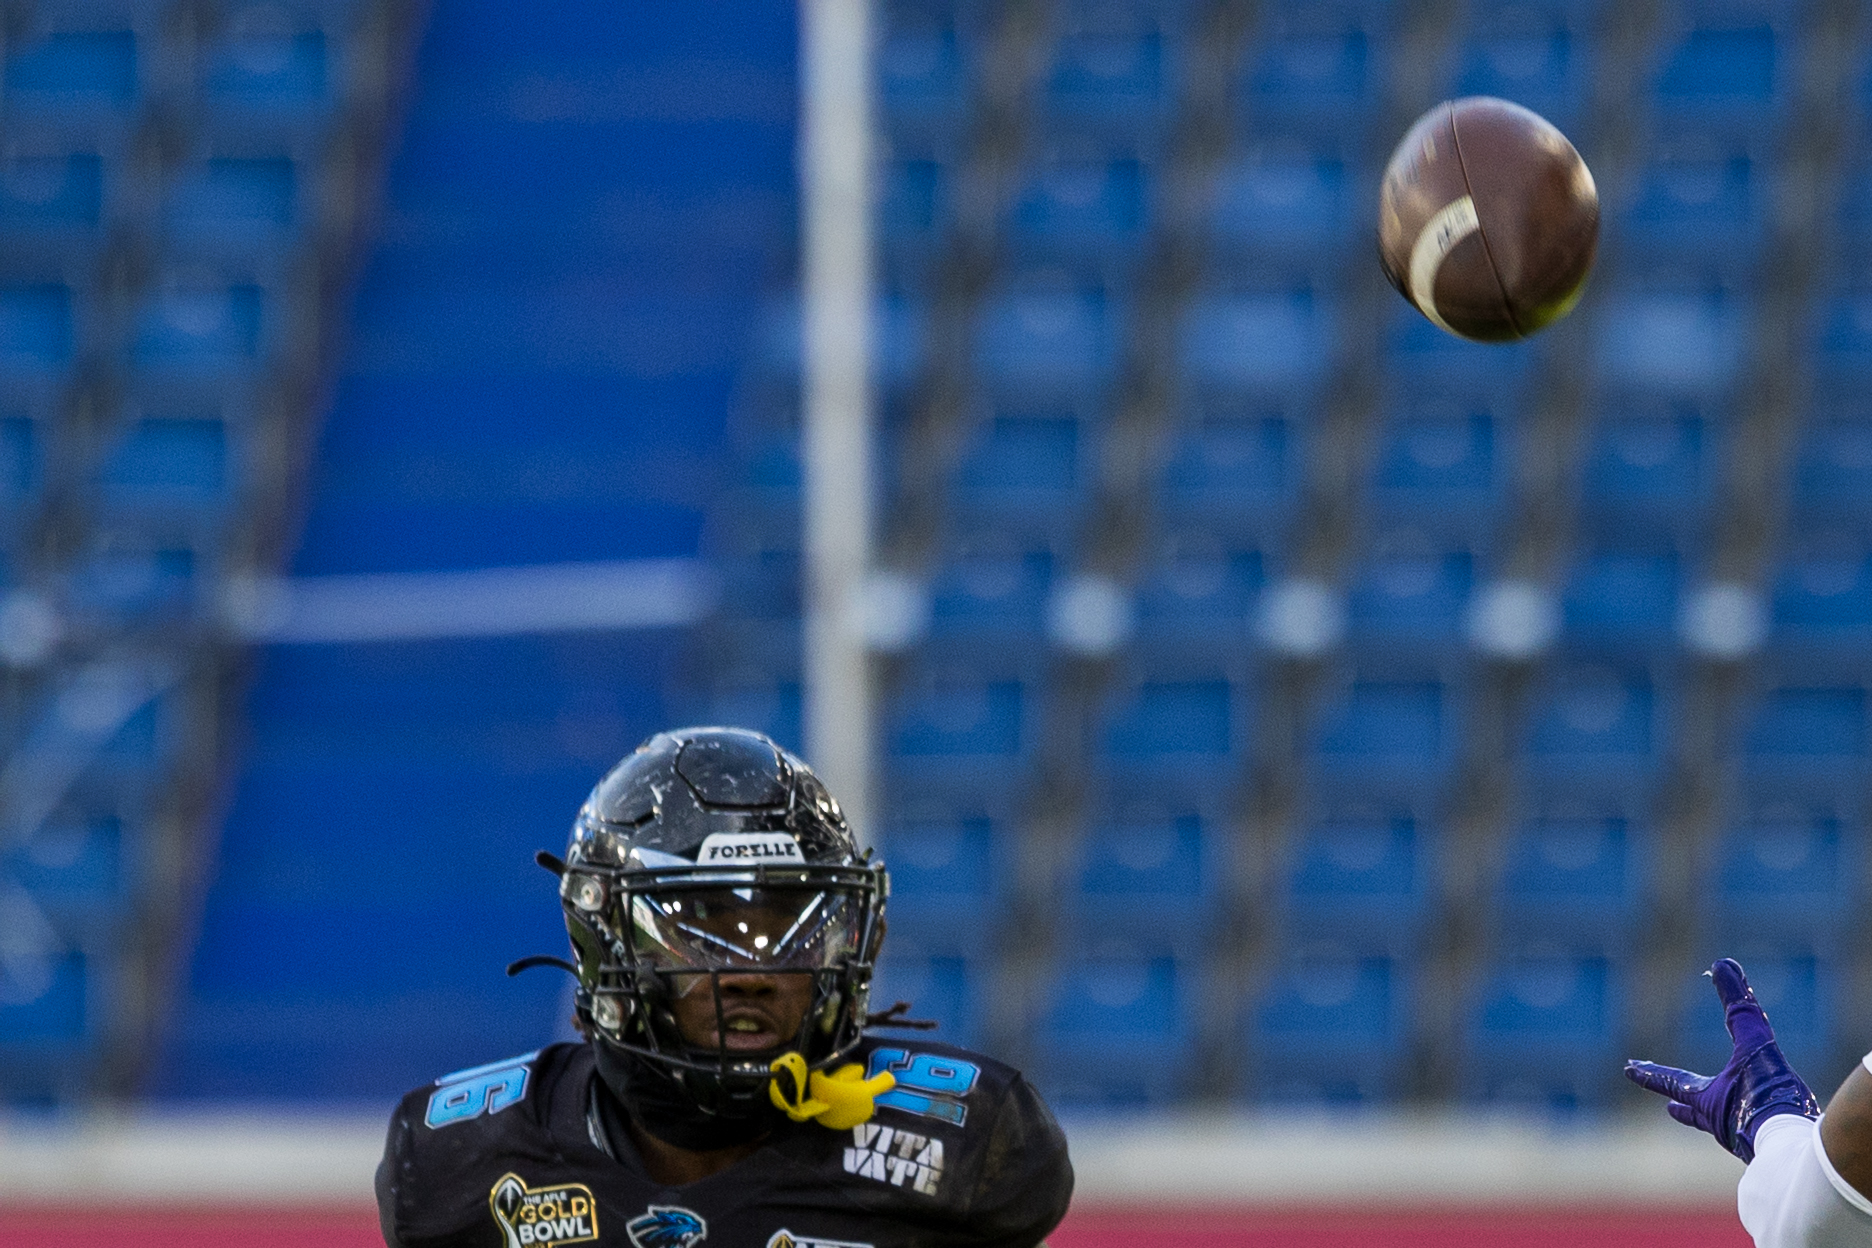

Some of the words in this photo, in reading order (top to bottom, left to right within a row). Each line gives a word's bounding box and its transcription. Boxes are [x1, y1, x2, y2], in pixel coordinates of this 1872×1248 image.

[709, 843, 795, 859] FORELLE
[853, 1123, 944, 1170] VITA
[843, 1147, 942, 1196] VATE
[520, 1197, 588, 1224] GOLD
[519, 1217, 591, 1244] BOWL
